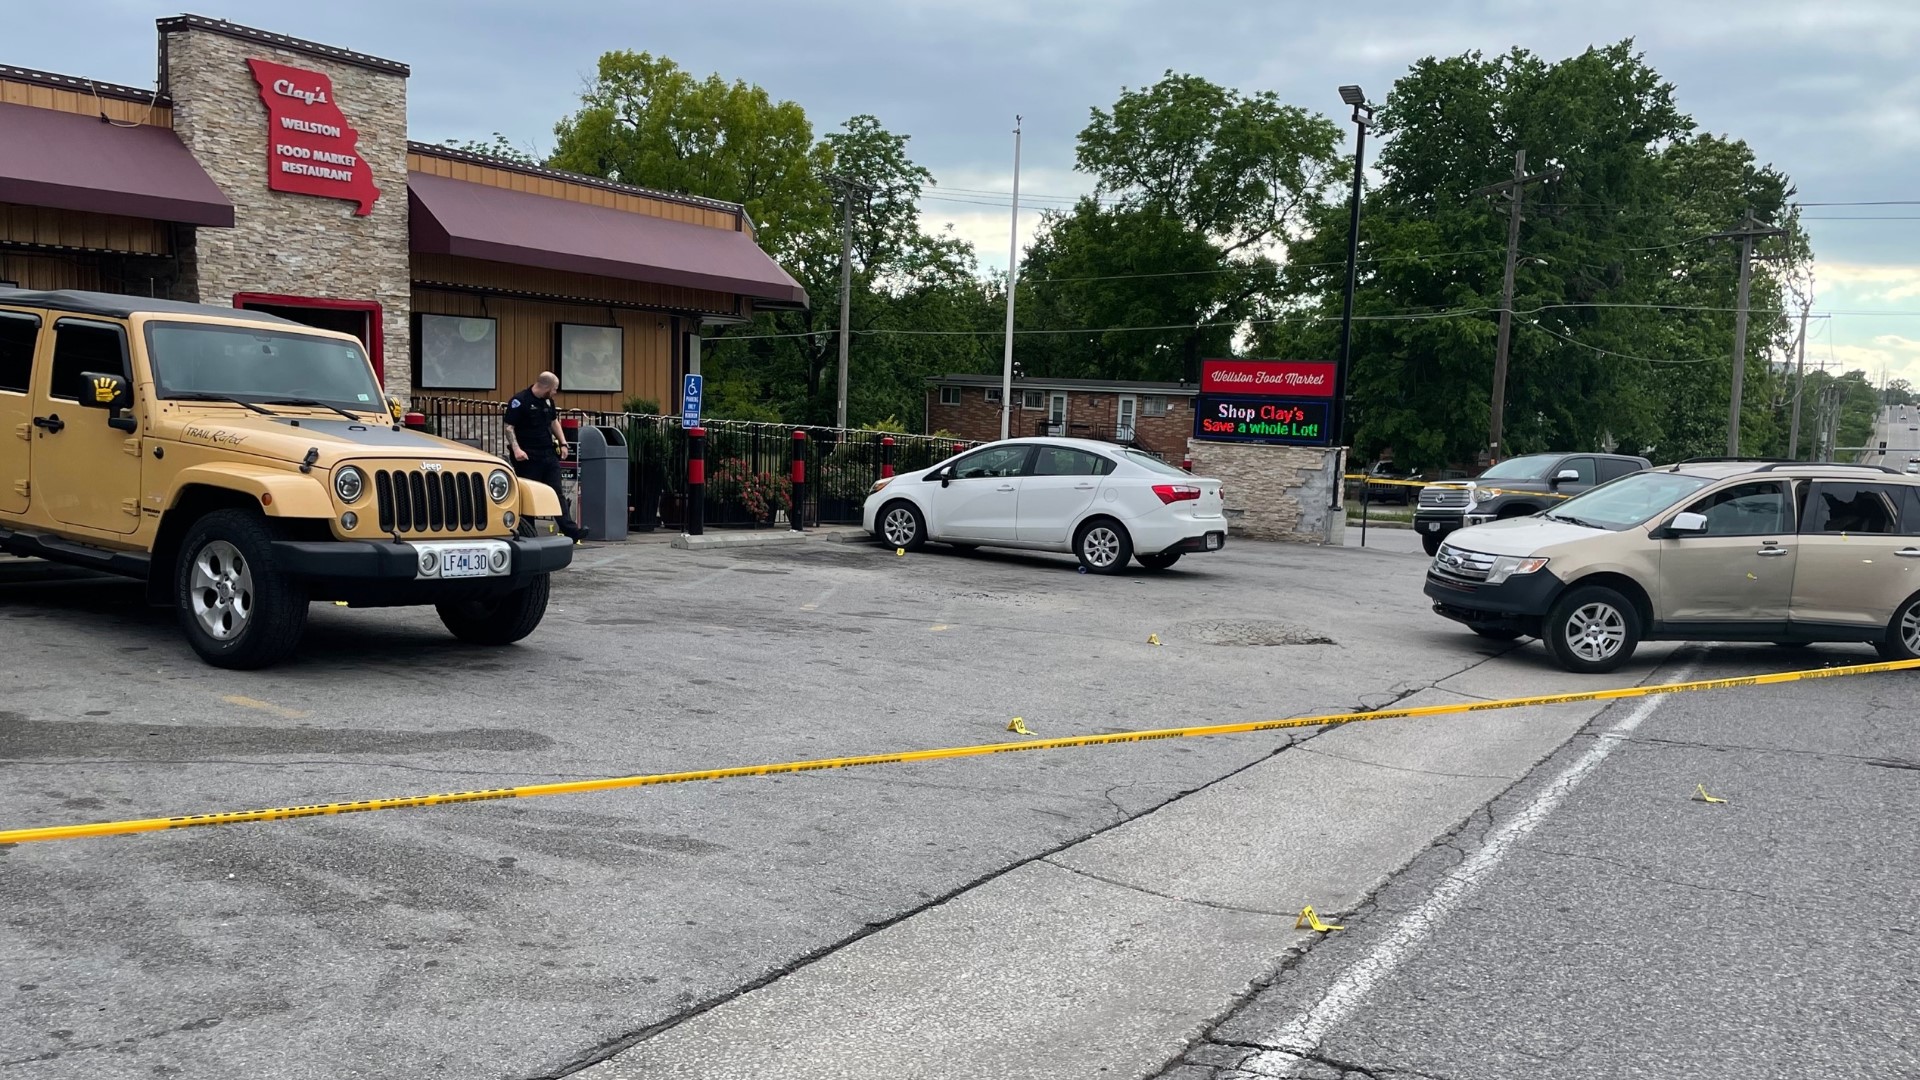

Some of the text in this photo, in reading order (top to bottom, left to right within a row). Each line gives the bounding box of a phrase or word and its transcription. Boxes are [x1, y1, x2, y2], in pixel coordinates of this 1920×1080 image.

[273, 79, 328, 105] Clay's
[281, 117, 341, 138] WELLSTON
[276, 144, 357, 167] FOOD MARKET
[282, 161, 353, 182] RESTAURANT
[1211, 370, 1325, 386] Wellston Food Market
[1218, 403, 1304, 424] Shop Clay's
[186, 426, 249, 447] TRAIL Rated
[1203, 418, 1318, 437] Save a whole Lot!
[420, 461, 442, 471] Jeep
